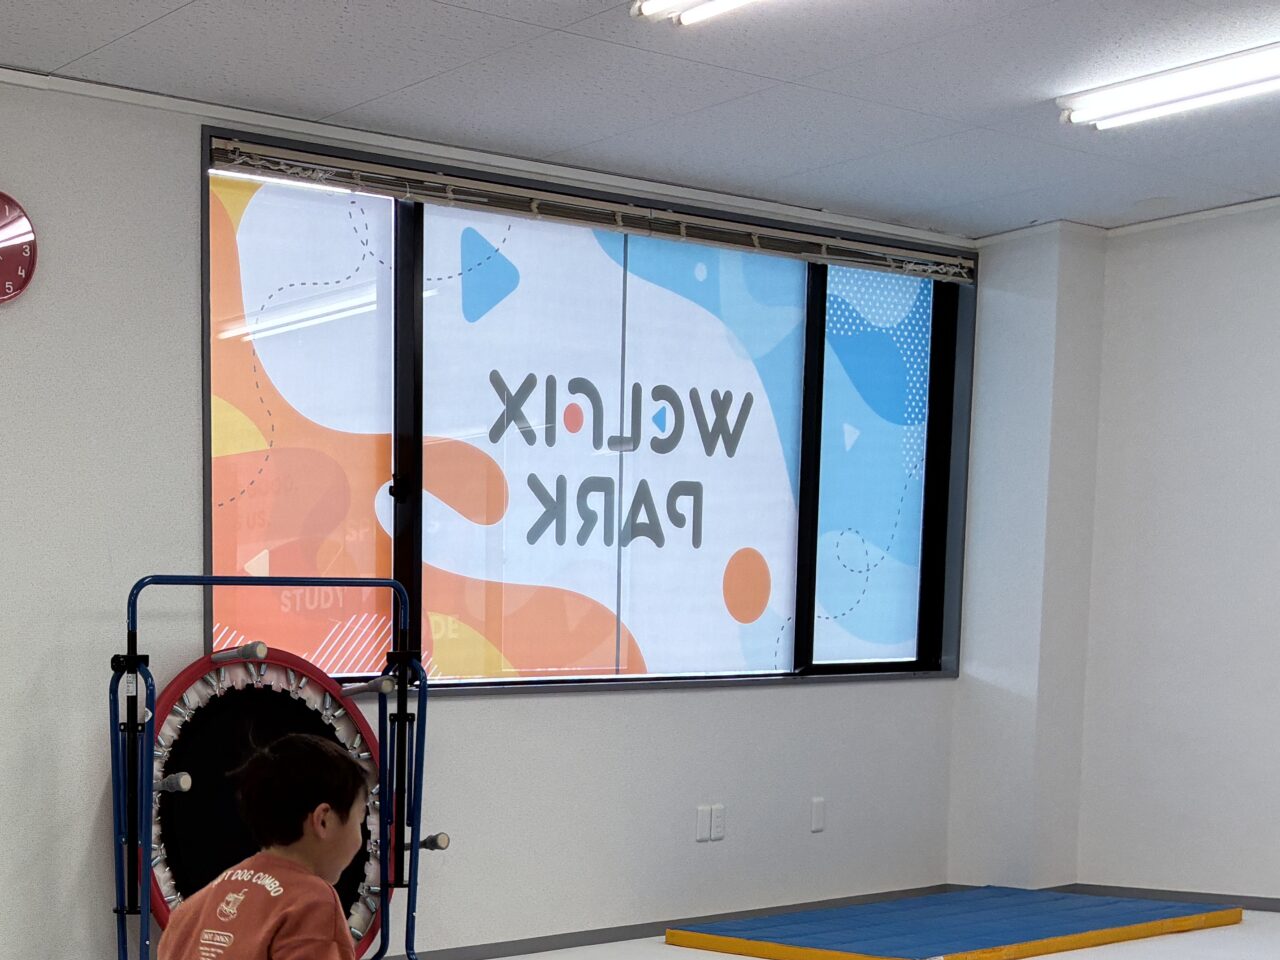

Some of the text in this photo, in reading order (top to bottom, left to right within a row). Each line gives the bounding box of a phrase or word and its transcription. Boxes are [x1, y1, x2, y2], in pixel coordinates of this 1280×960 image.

[5, 205, 9, 216] 1
[23, 245, 31, 256] 3
[18, 266, 25, 278] 4
[6, 282, 13, 293] 5
[231, 869, 254, 881] DOG
[251, 872, 284, 897] COMBO
